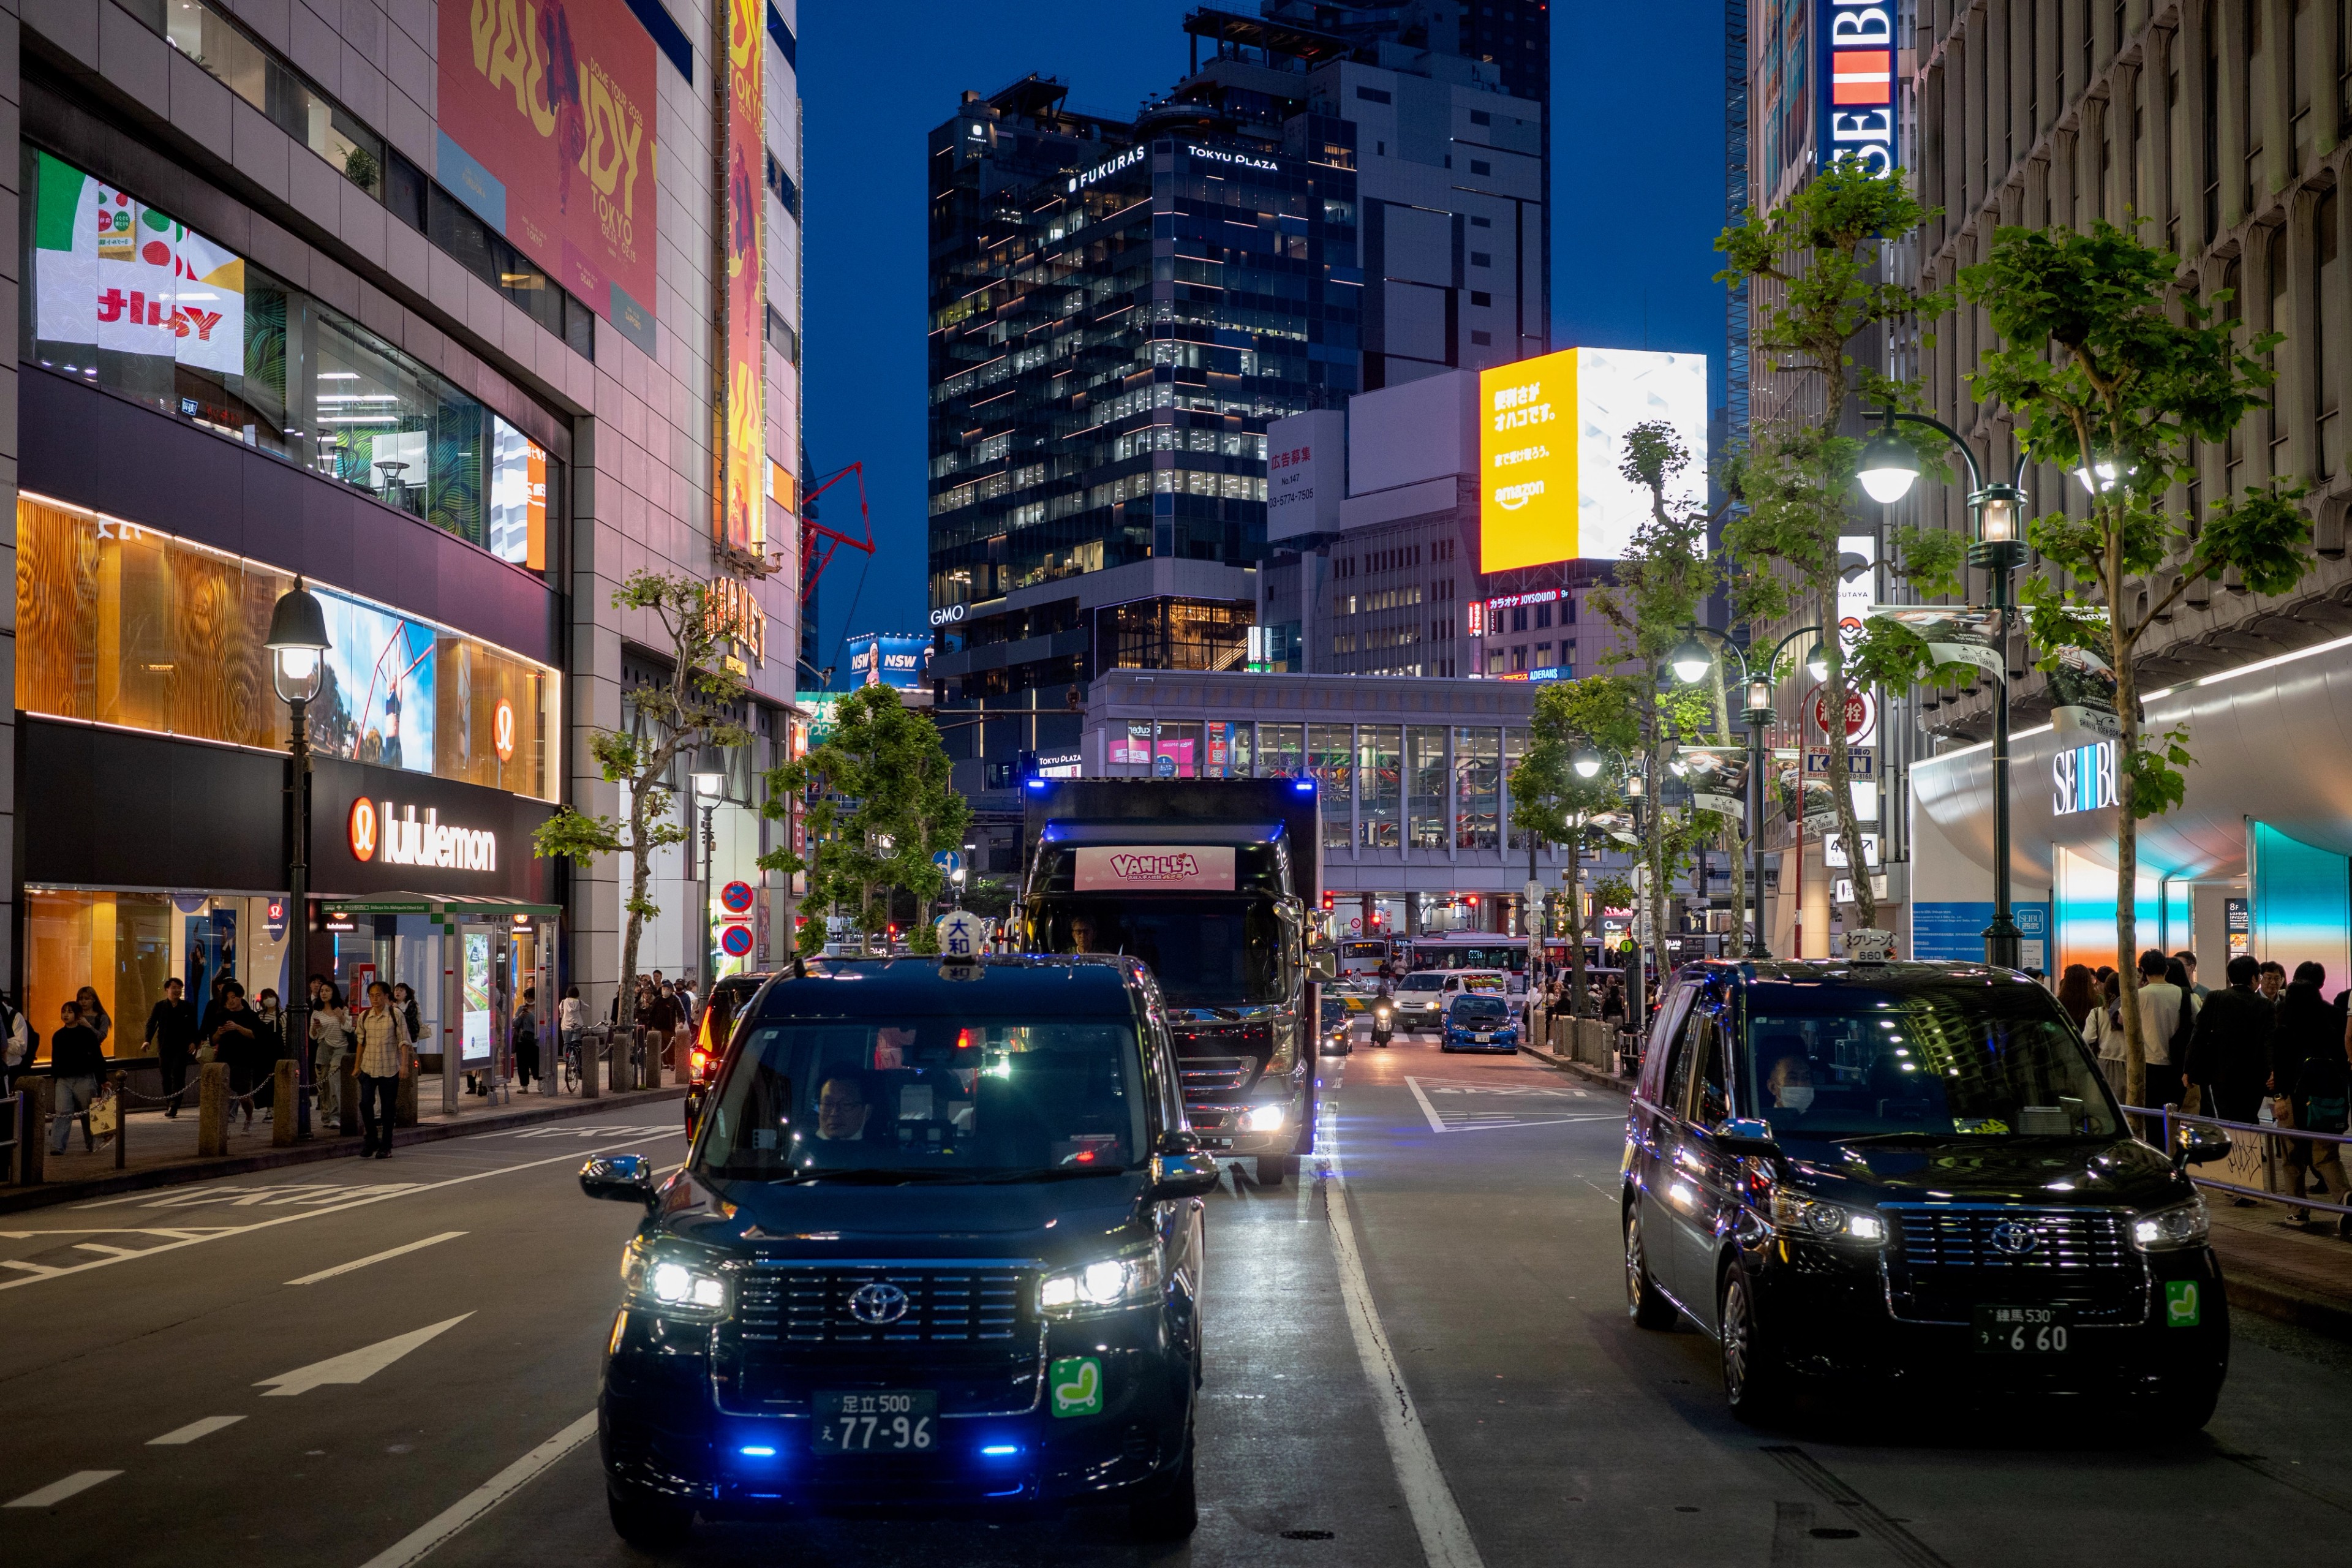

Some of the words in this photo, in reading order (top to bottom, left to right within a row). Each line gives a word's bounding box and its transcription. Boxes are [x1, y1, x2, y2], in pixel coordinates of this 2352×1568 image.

[590, 56, 609, 90] DOME
[611, 81, 627, 108] TOUR
[628, 101, 643, 127] 2026
[1833, 0, 1891, 181] SEIB
[1080, 145, 1145, 188] FUKURAS
[1188, 145, 1231, 162] TOKYU
[1235, 154, 1278, 171] PLAZA
[591, 184, 633, 246] TOKYO
[527, 227, 543, 247] TOKYO
[601, 222, 617, 246] 02.14
[622, 243, 636, 263] 02.15
[581, 273, 594, 291] OSAKA
[1271, 446, 1311, 470] 広告募集
[1281, 473, 1300, 486] No.147
[1268, 488, 1314, 508] 03-5774-7505
[1494, 480, 1545, 503] amazon
[1490, 596, 1519, 609] カラオケ
[1520, 590, 1556, 605] JOYSOUND
[1561, 589, 1569, 598] 9F
[704, 576, 767, 669] MAGNET
[930, 605, 964, 625] GMO
[851, 652, 870, 670] NSW
[884, 654, 917, 668] NSW
[1529, 668, 1558, 681] ADERANS
[1820, 703, 1863, 722] 消栓
[2079, 719, 2096, 730] SHIBUYA
[2098, 724, 2121, 738] KOEN-DORI
[1060, 754, 1082, 763] PLAZA
[1812, 756, 1867, 772] KN
[383, 801, 496, 872] lululemon
[1110, 854, 1199, 877] VANILLA
[2019, 914, 2041, 922] SEIBU
[948, 919, 970, 954] 大和
[1853, 935, 1889, 946] グリーン
[1860, 951, 1881, 960] 660
[1996, 1310, 2024, 1322] 練馬
[2025, 1309, 2051, 1322] 530
[842, 1395, 876, 1413] 足立
[879, 1395, 911, 1412] 500
[821, 1425, 834, 1441] え
[839, 1415, 931, 1450] 77-96
